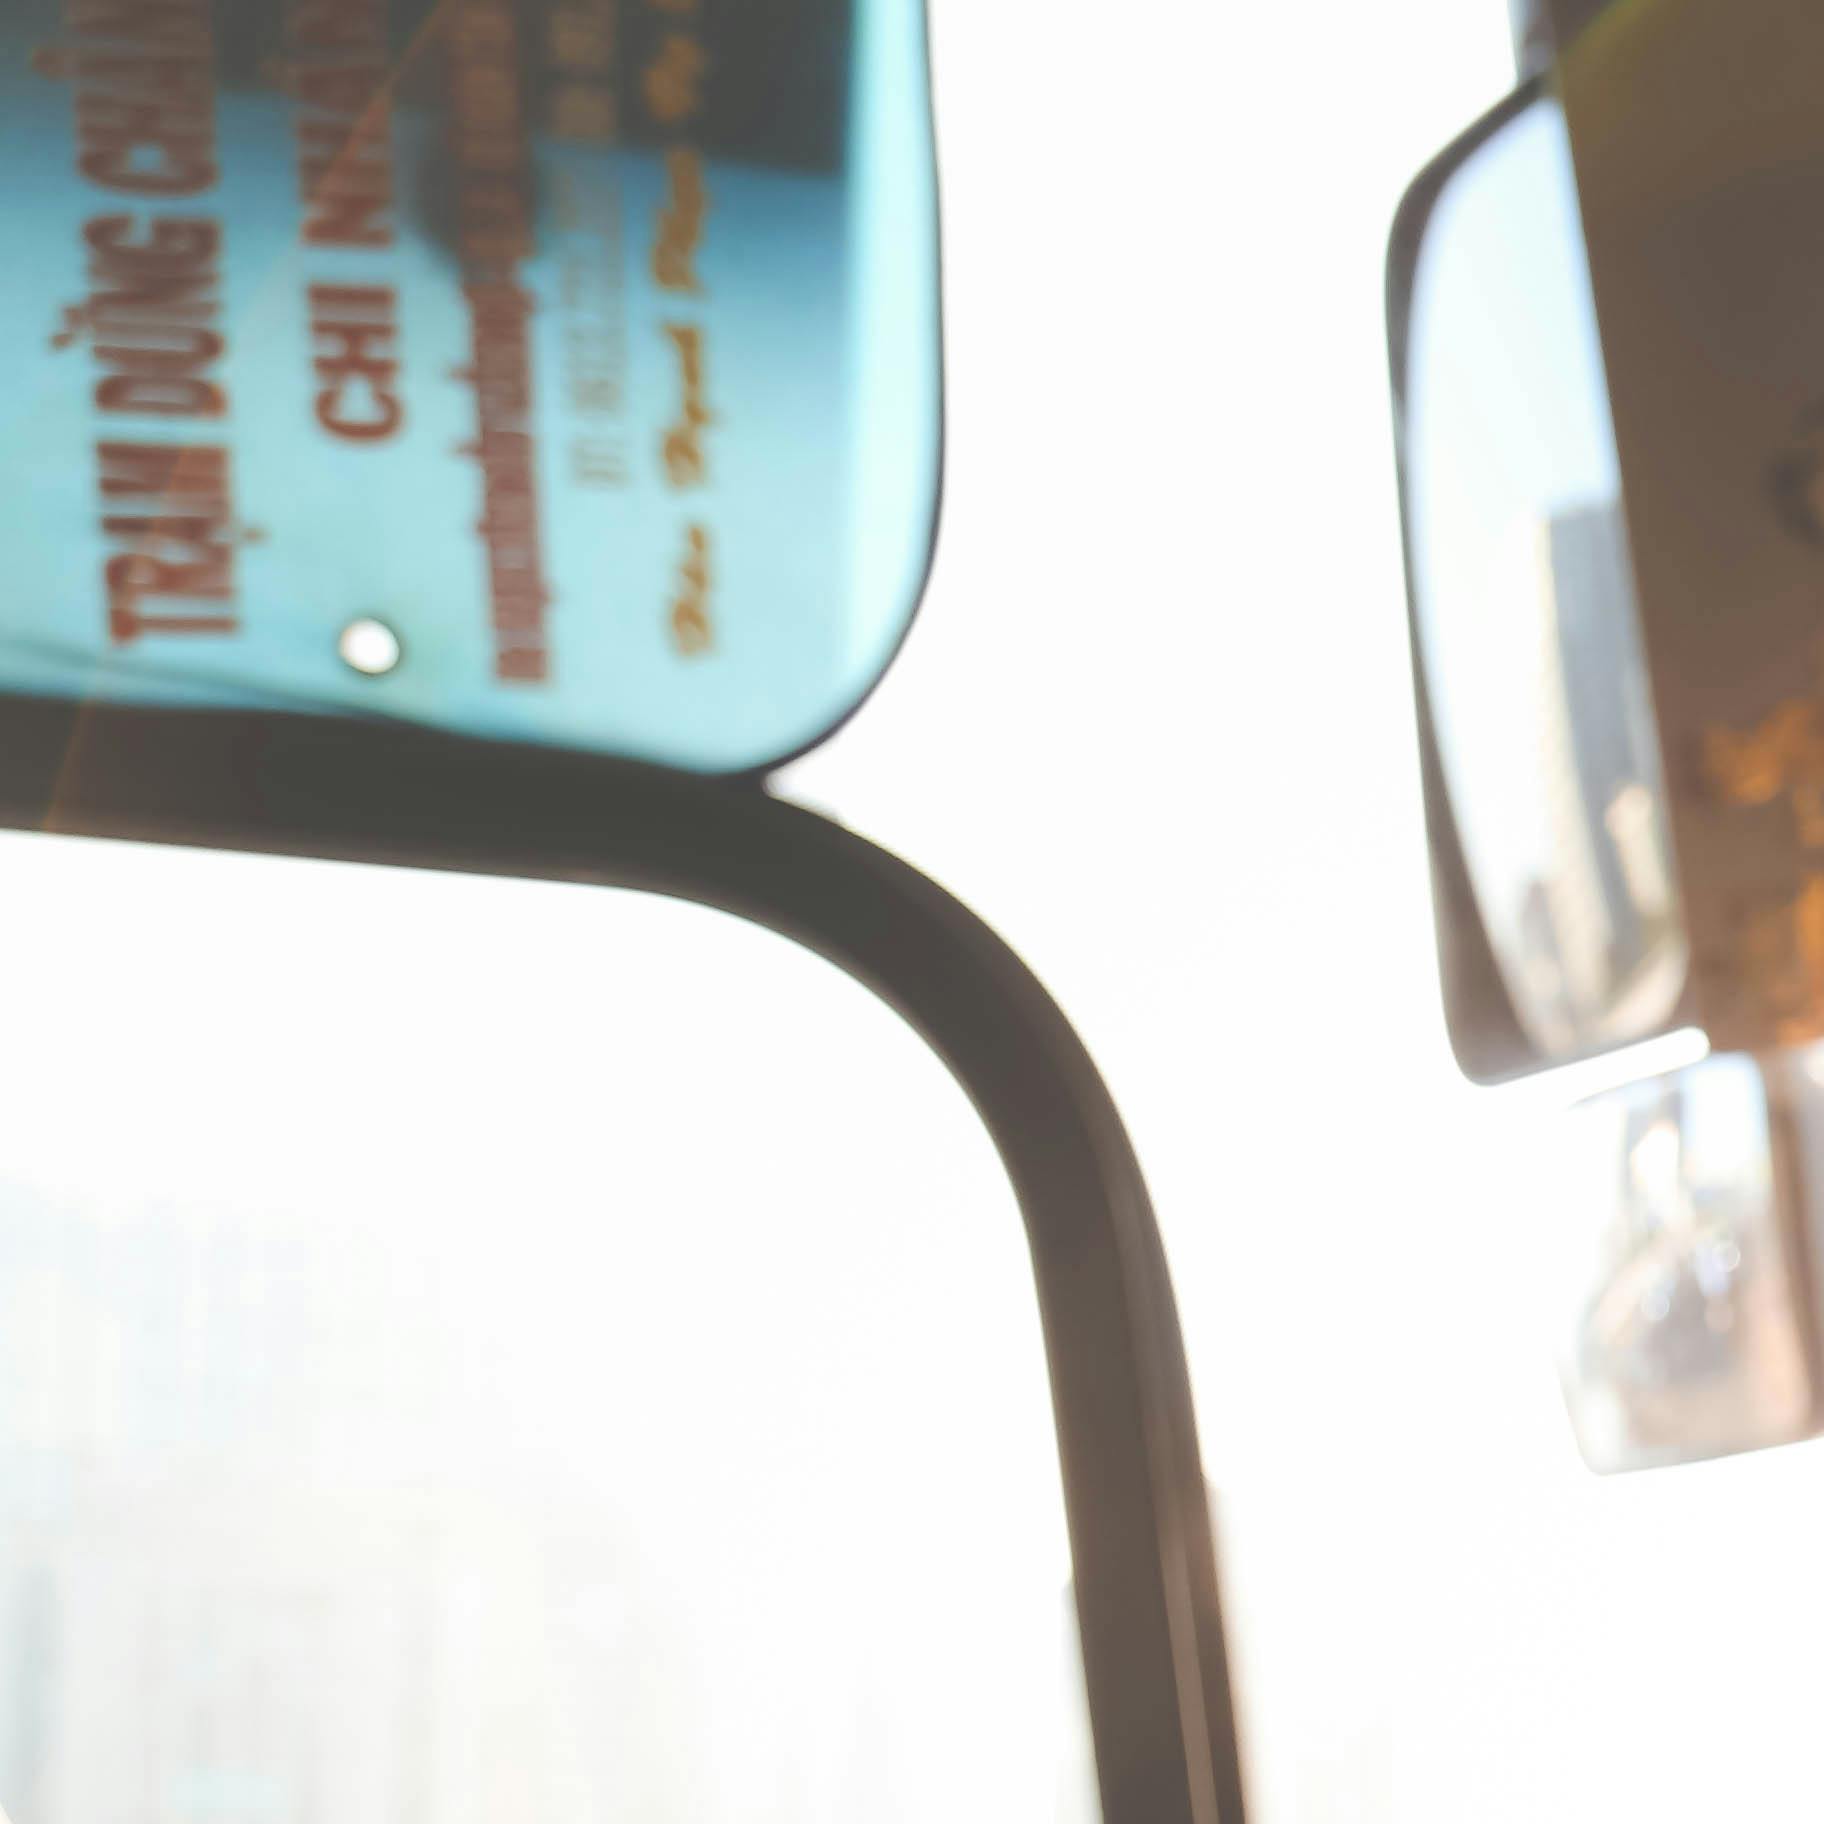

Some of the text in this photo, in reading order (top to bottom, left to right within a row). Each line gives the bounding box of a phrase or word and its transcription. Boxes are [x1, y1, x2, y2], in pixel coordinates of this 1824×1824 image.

[50, 216, 231, 421] DỪNG
[310, 284, 406, 446] CHI
[94, 442, 265, 645] TRẠM
